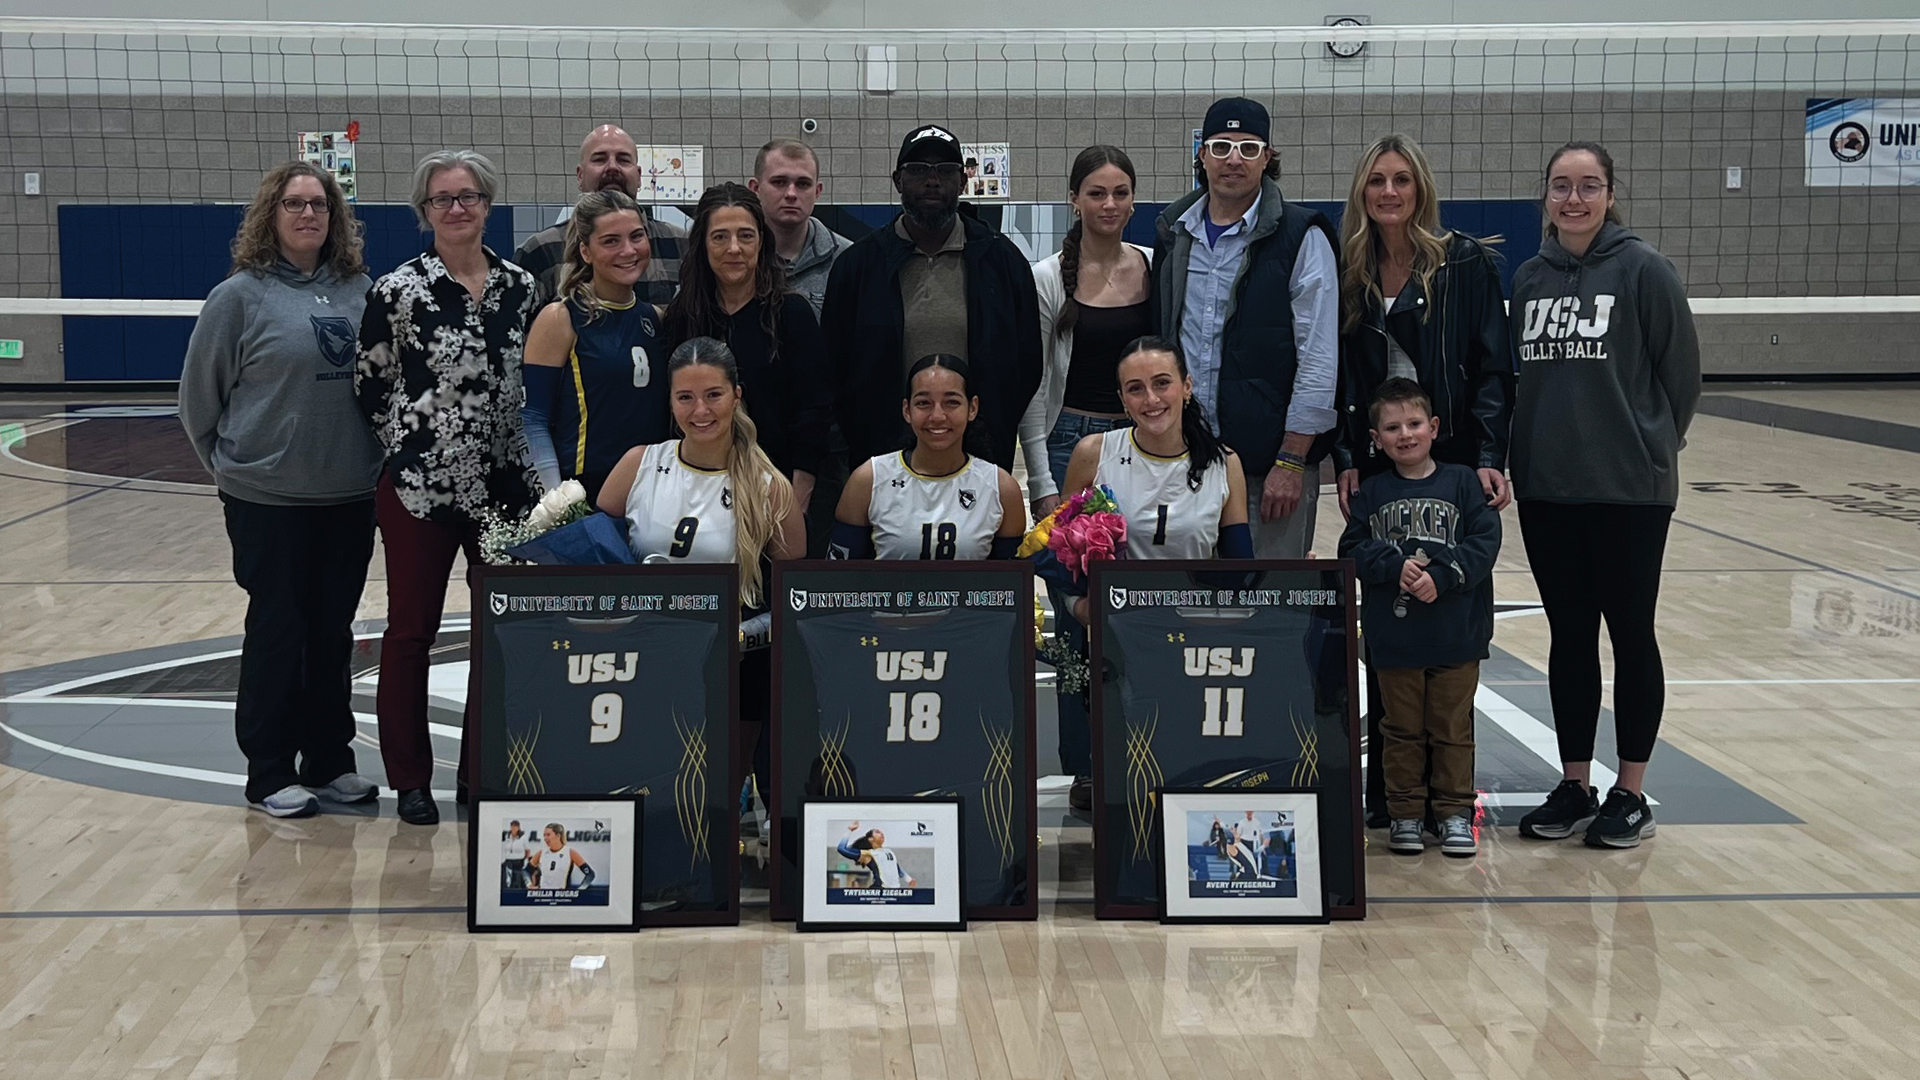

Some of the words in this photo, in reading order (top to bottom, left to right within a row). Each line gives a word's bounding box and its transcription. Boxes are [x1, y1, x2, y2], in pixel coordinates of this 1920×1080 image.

[1880, 123, 1920, 146] UNI
[1523, 294, 1616, 342] USJ
[631, 346, 650, 388] 8
[669, 516, 699, 558] 9
[1152, 504, 1168, 546] 1
[919, 522, 957, 561] 18
[509, 595, 594, 612] UNIVERSITY
[600, 595, 616, 611] OF
[621, 594, 664, 611] SAINT
[669, 594, 719, 611] JOSEPH
[809, 591, 892, 608] UNIVERSITY
[897, 591, 914, 607] OF
[918, 591, 961, 607] SAINT
[965, 590, 1015, 607] JOSEPH
[1129, 590, 1213, 606] UNIVERSITY
[1218, 590, 1234, 606] OF
[1239, 590, 1282, 606] SAINT
[1287, 589, 1337, 606] JOSEPH
[568, 651, 639, 684] USJ
[875, 651, 948, 681] USJ
[1184, 646, 1255, 677] USJ
[590, 692, 623, 744] 9
[886, 691, 942, 742] 18
[1202, 686, 1244, 737] 11
[527, 890, 553, 898] EMILIA
[882, 889, 913, 897] ZIEGLER
[1206, 881, 1230, 889] AVERY
[1231, 881, 1277, 889] FITZGERALD
